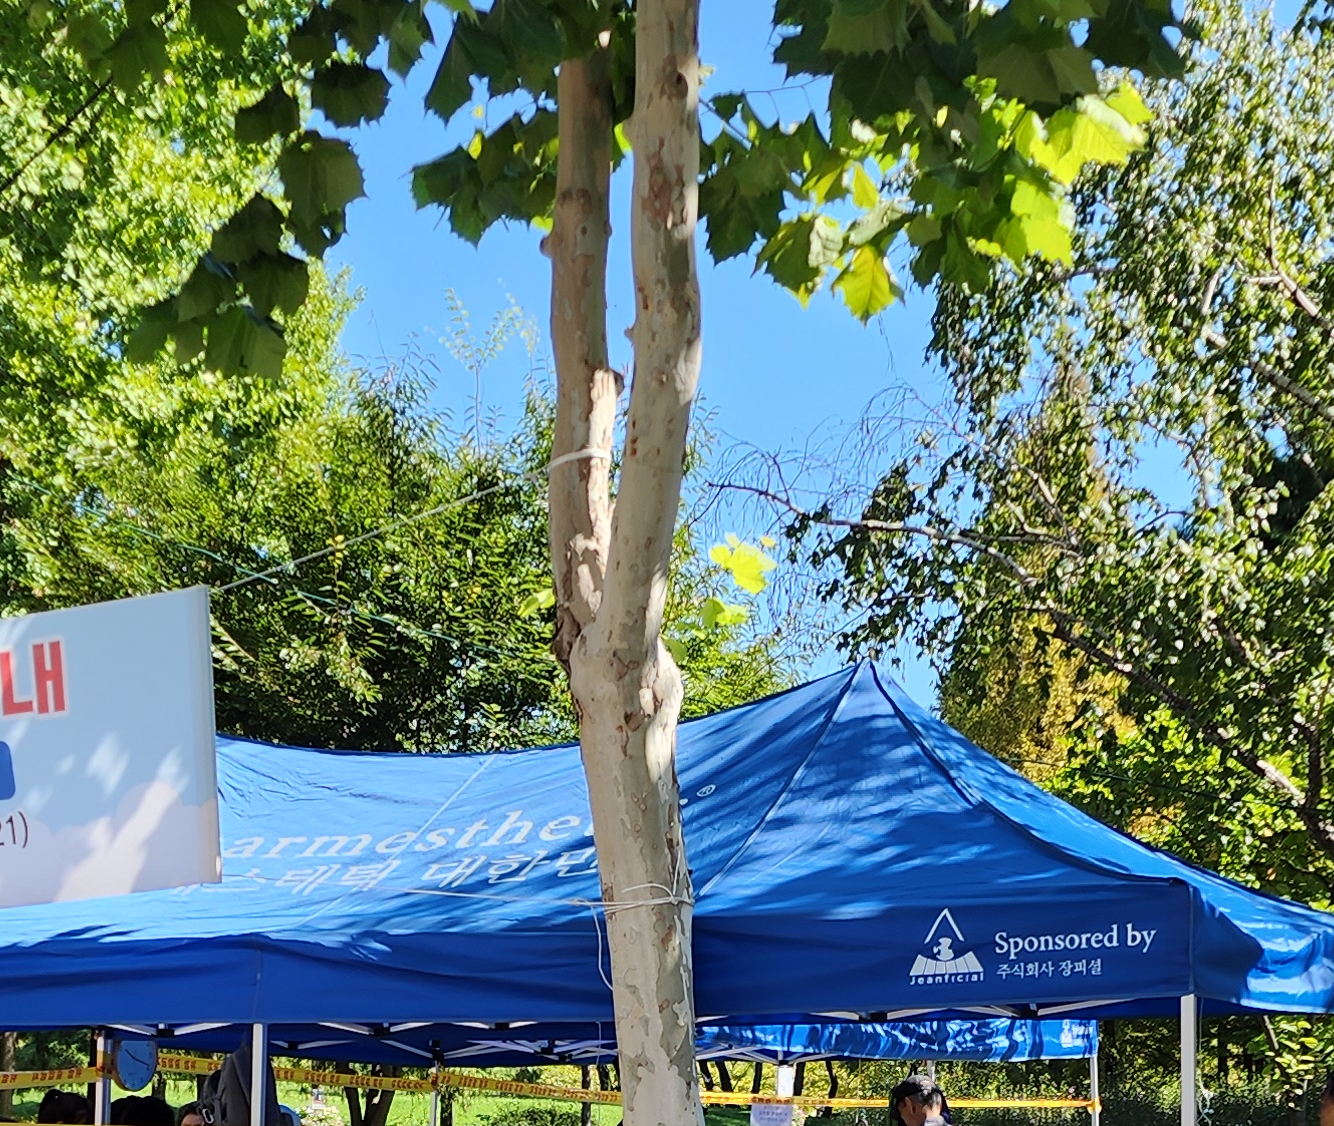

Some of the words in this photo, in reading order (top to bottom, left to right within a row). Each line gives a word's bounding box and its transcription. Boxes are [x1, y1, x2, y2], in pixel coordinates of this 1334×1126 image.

[224, 810, 595, 860] armesthe
[420, 844, 599, 888] 대한민
[994, 923, 1119, 960] Sponsored
[1126, 922, 1157, 953] by
[995, 960, 1055, 980] 주식회사
[1058, 958, 1102, 977] 장피셜
